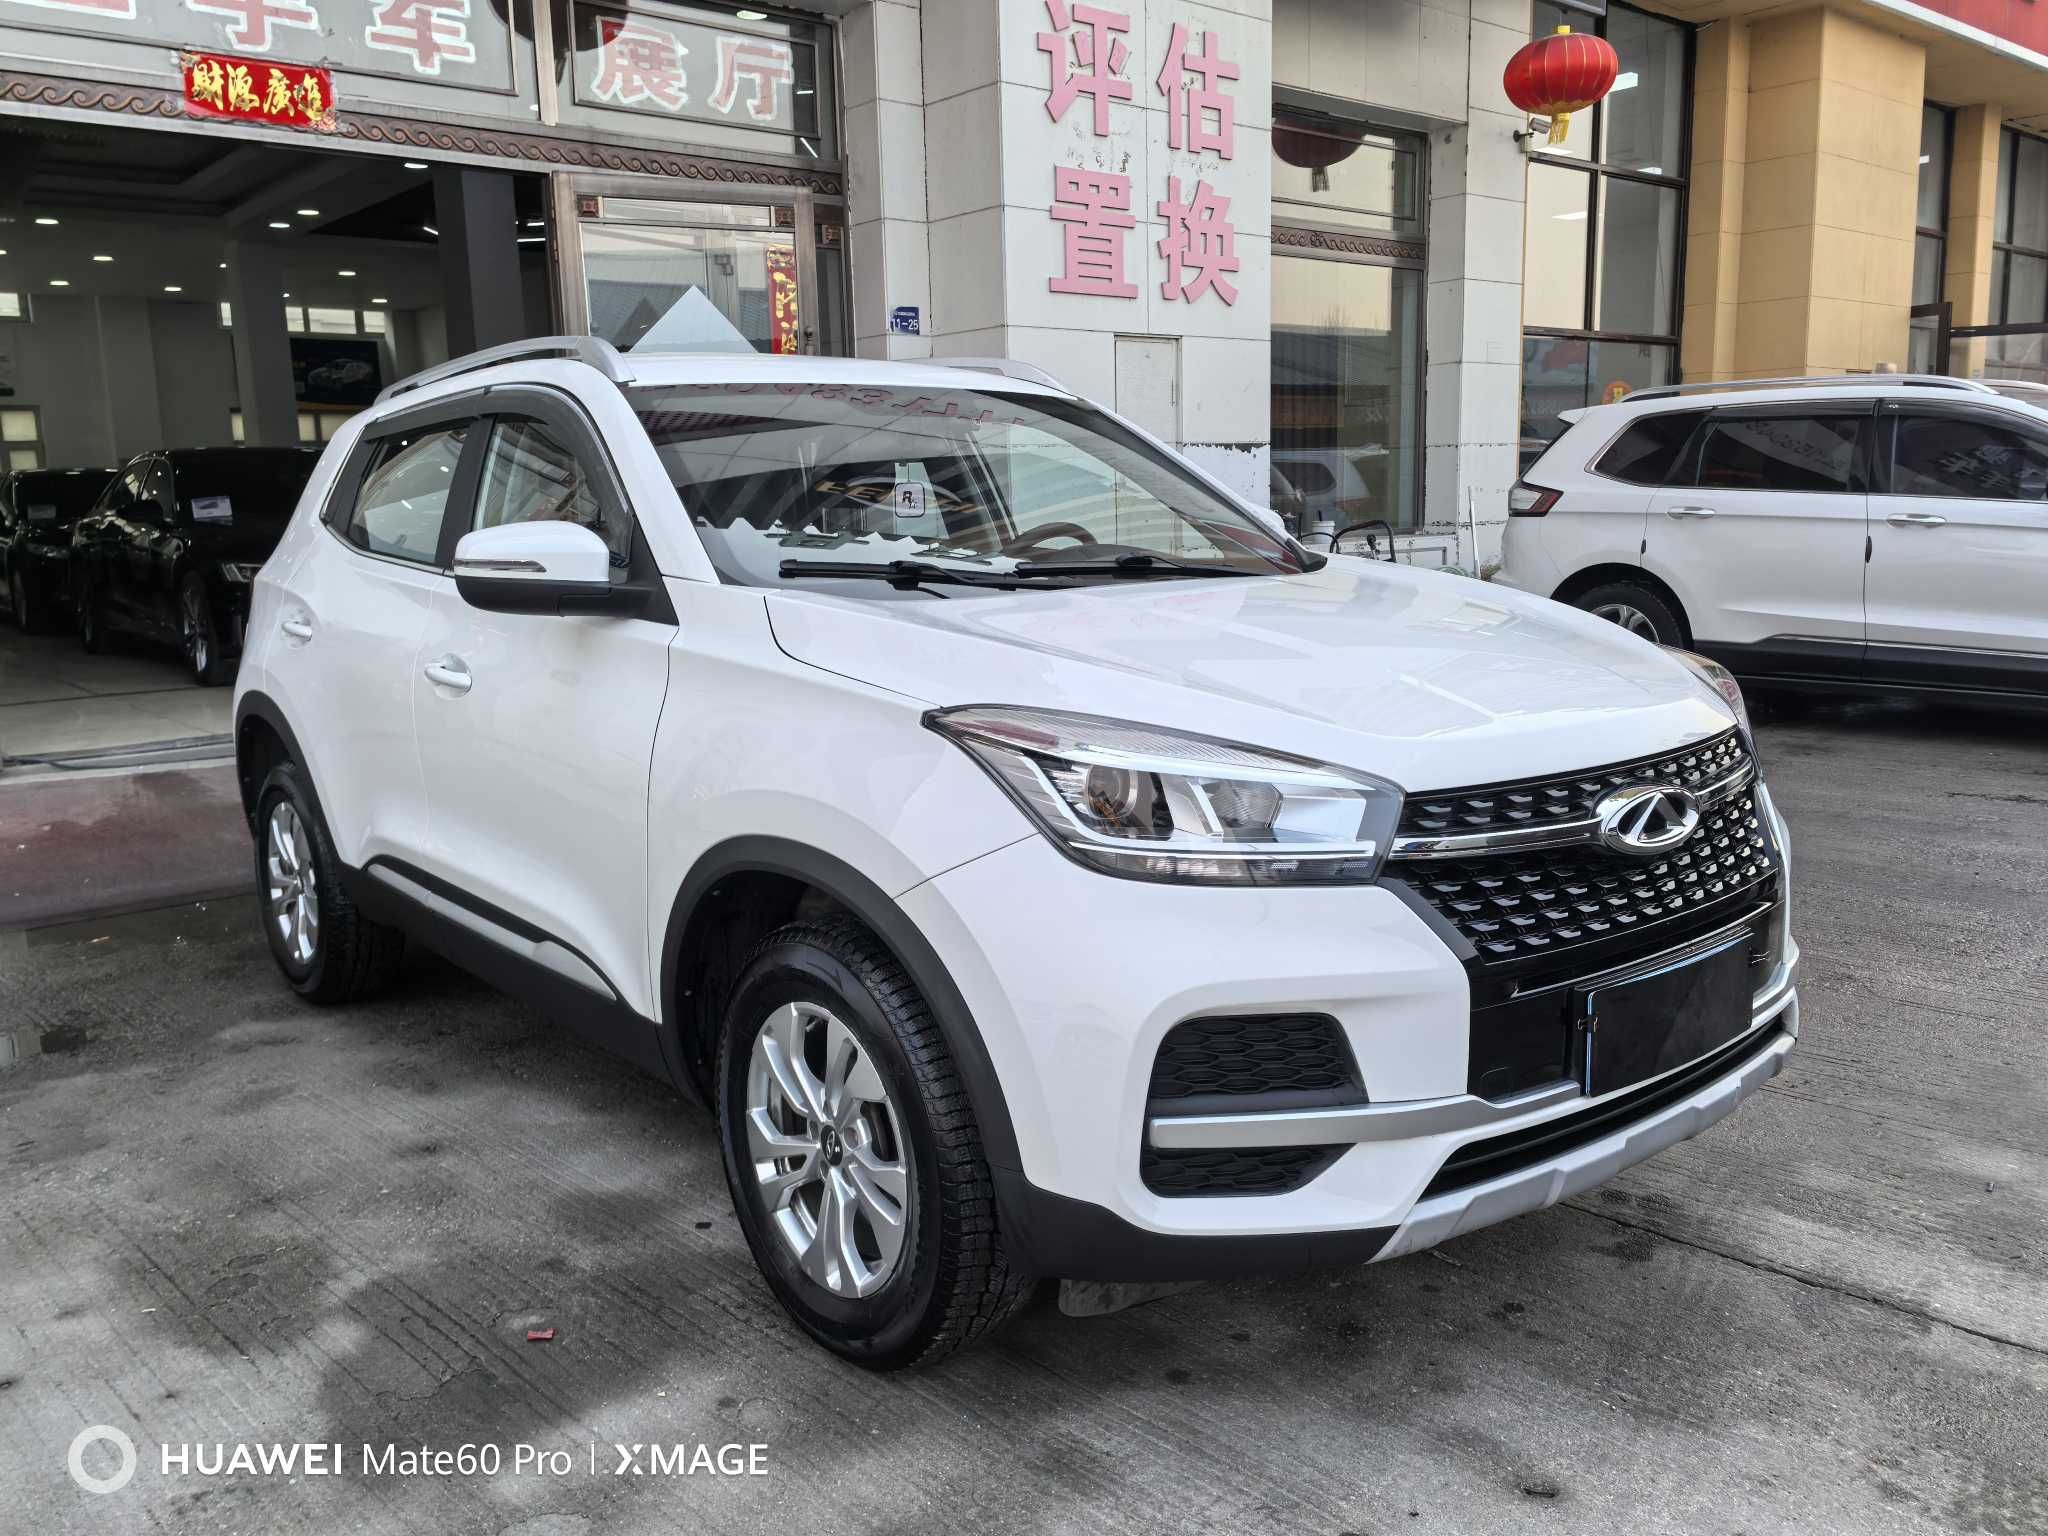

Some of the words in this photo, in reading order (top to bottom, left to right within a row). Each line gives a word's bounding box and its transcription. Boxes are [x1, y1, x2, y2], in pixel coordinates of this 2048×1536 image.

[591, 16, 795, 121] 展厅
[1036, 0, 1241, 160] 评估
[1048, 164, 1241, 307] 置换
